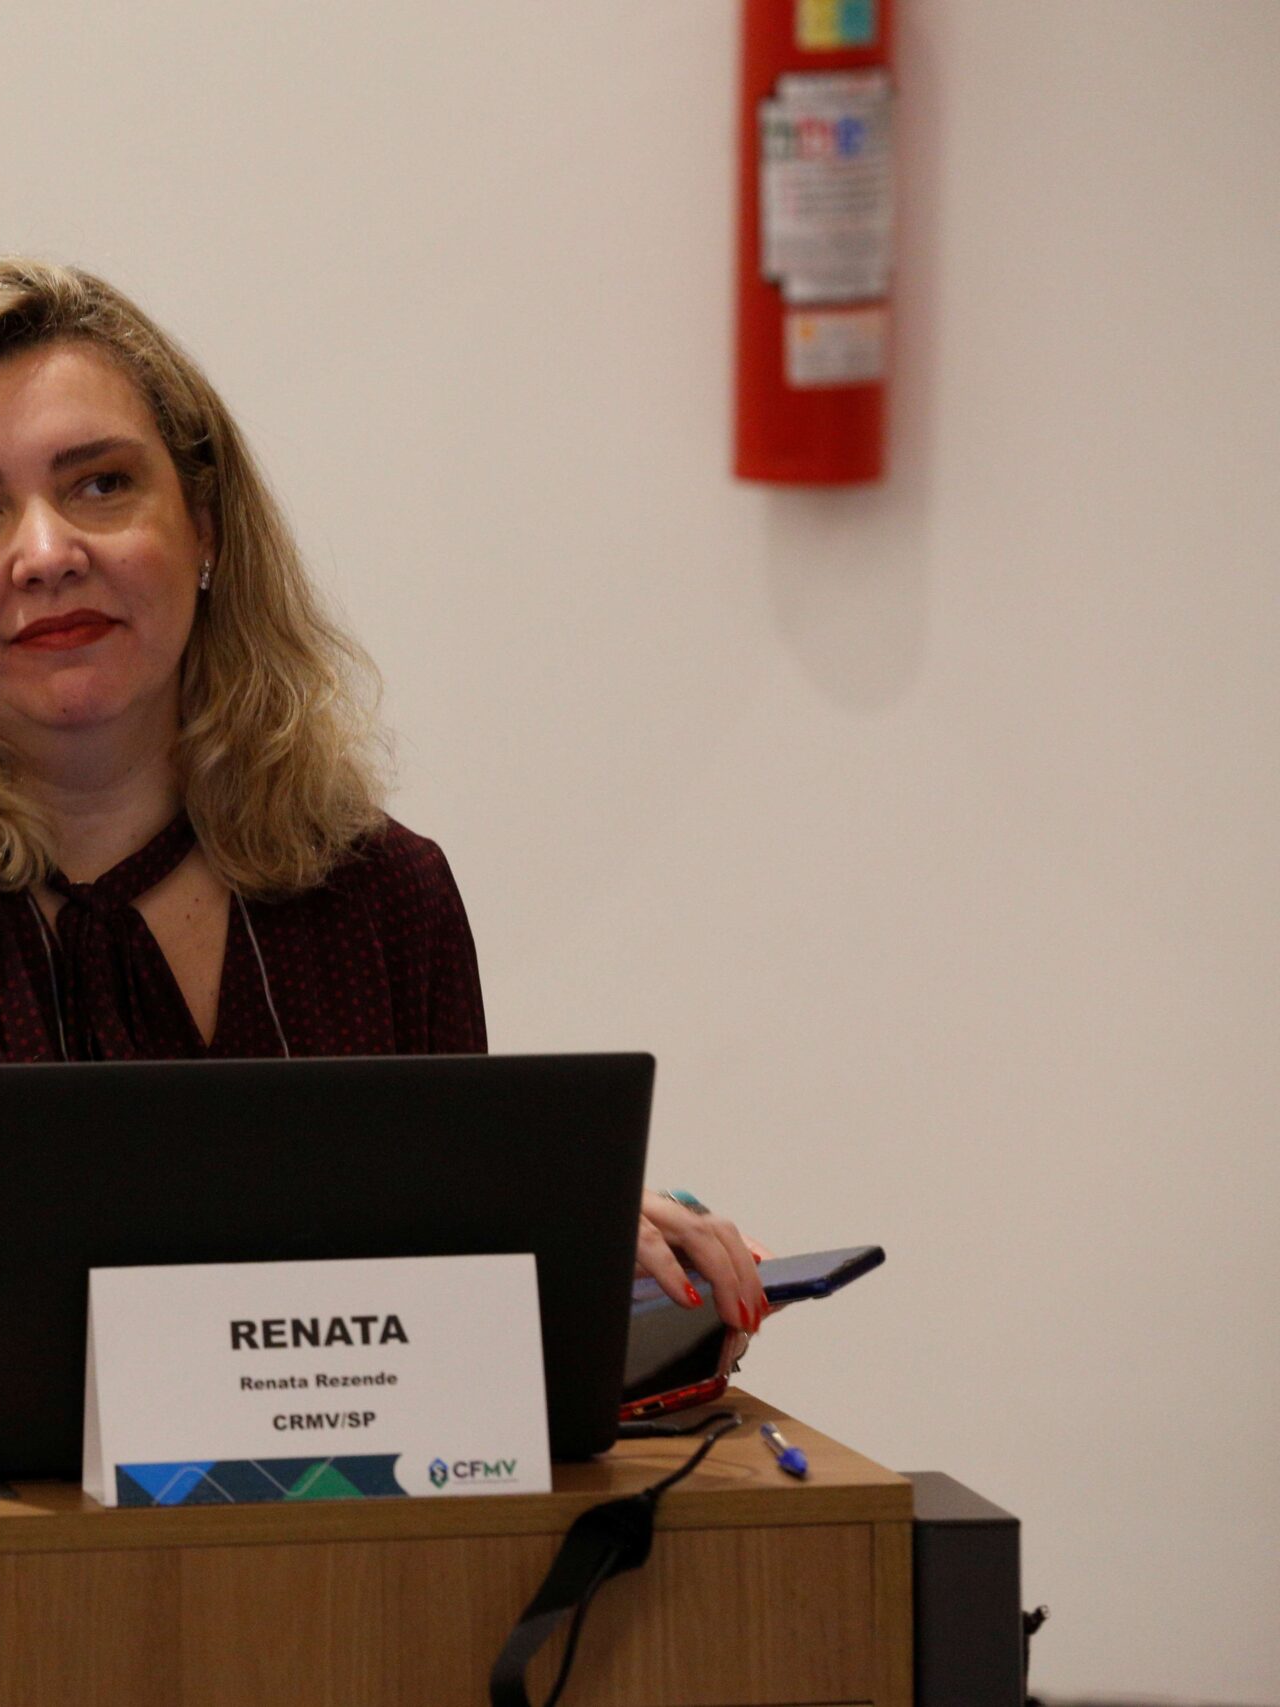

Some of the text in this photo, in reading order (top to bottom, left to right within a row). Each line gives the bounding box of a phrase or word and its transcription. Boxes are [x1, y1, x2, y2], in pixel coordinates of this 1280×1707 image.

[230, 1315, 409, 1350] RENATA
[240, 1372, 398, 1391] Renata Rezende
[273, 1412, 376, 1431] CRMV/SP
[452, 1459, 517, 1478] CFMV
